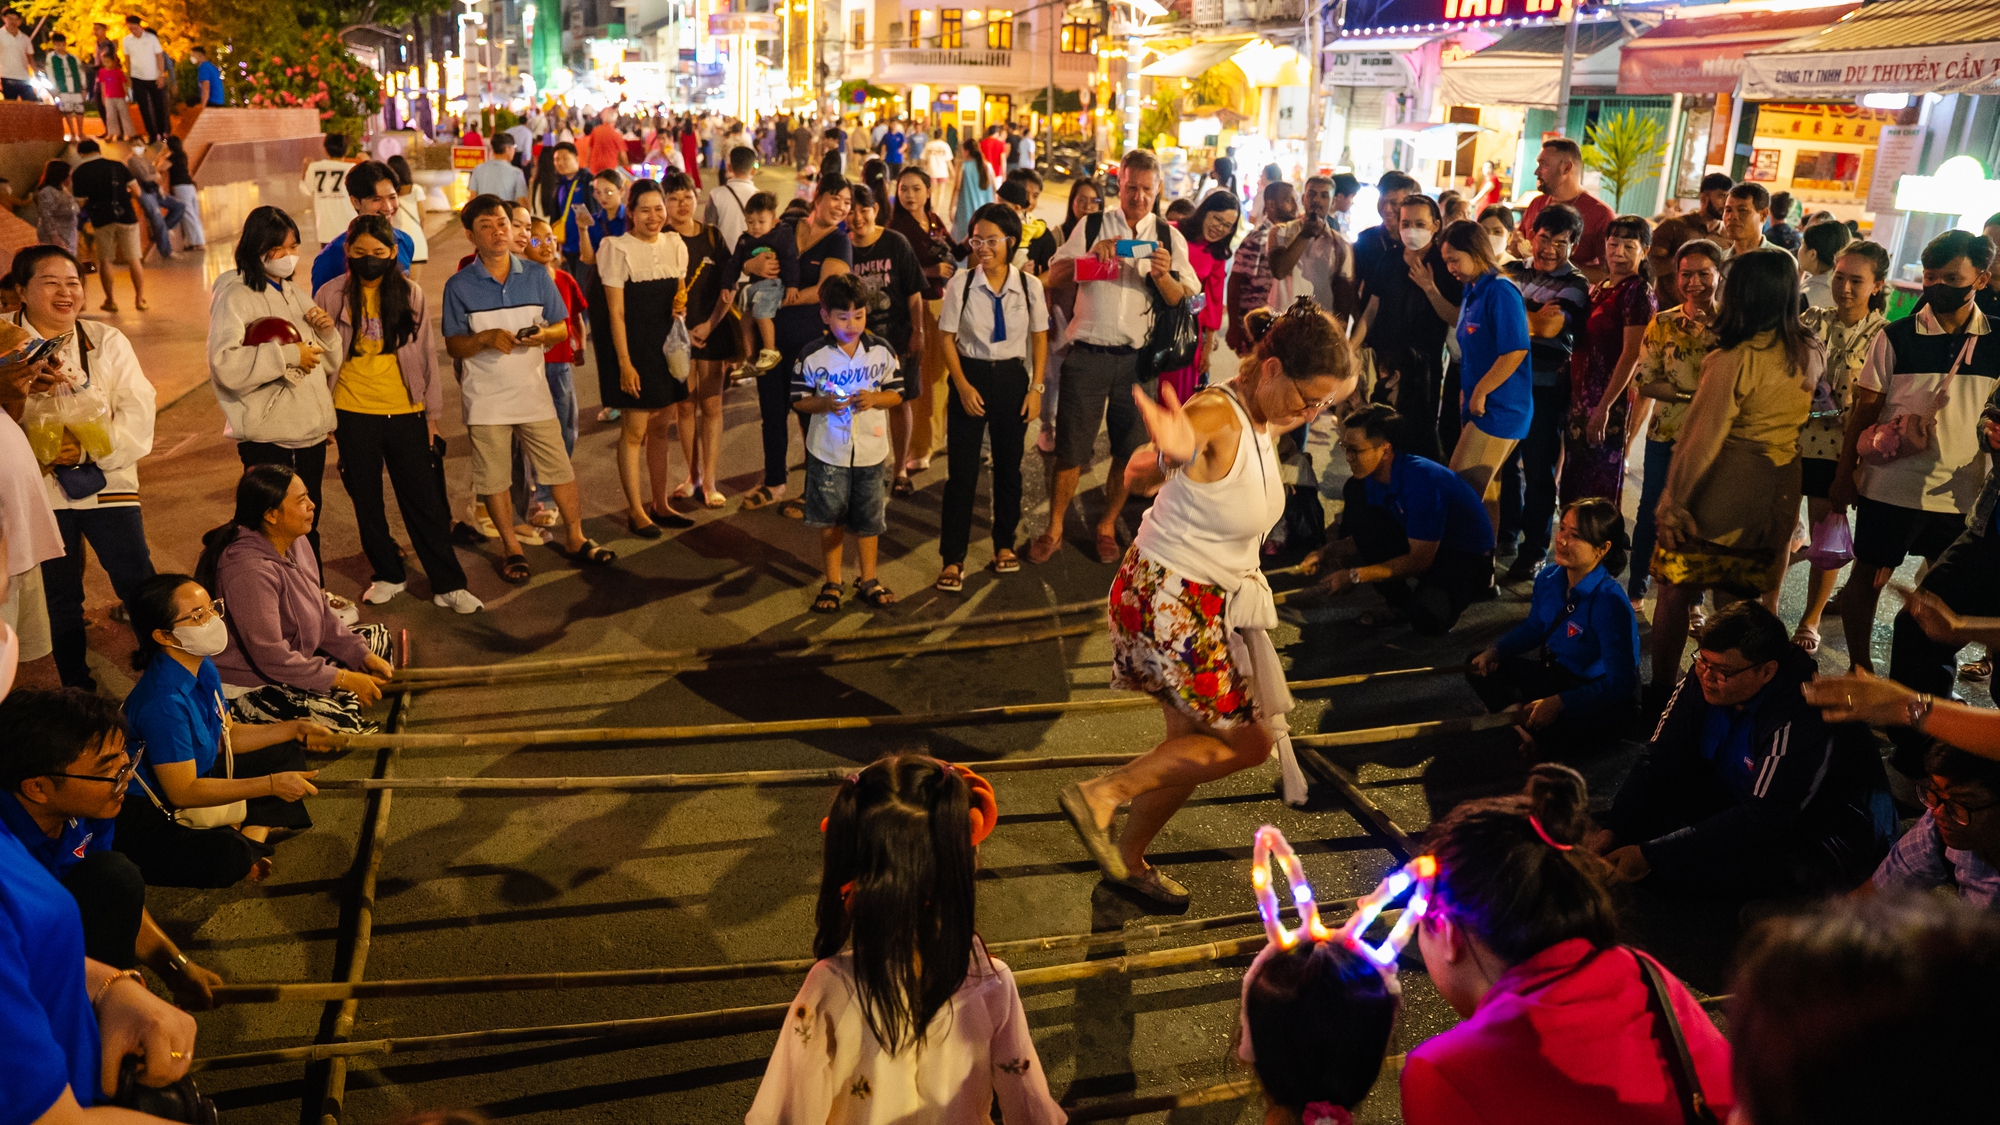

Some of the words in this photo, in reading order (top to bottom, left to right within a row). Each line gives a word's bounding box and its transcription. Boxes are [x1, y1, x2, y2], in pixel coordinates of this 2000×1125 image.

[1803, 69, 1814, 83] TY
[1816, 69, 1842, 82] TNHH
[1844, 65, 1868, 85] DU
[314, 171, 344, 193] 77
